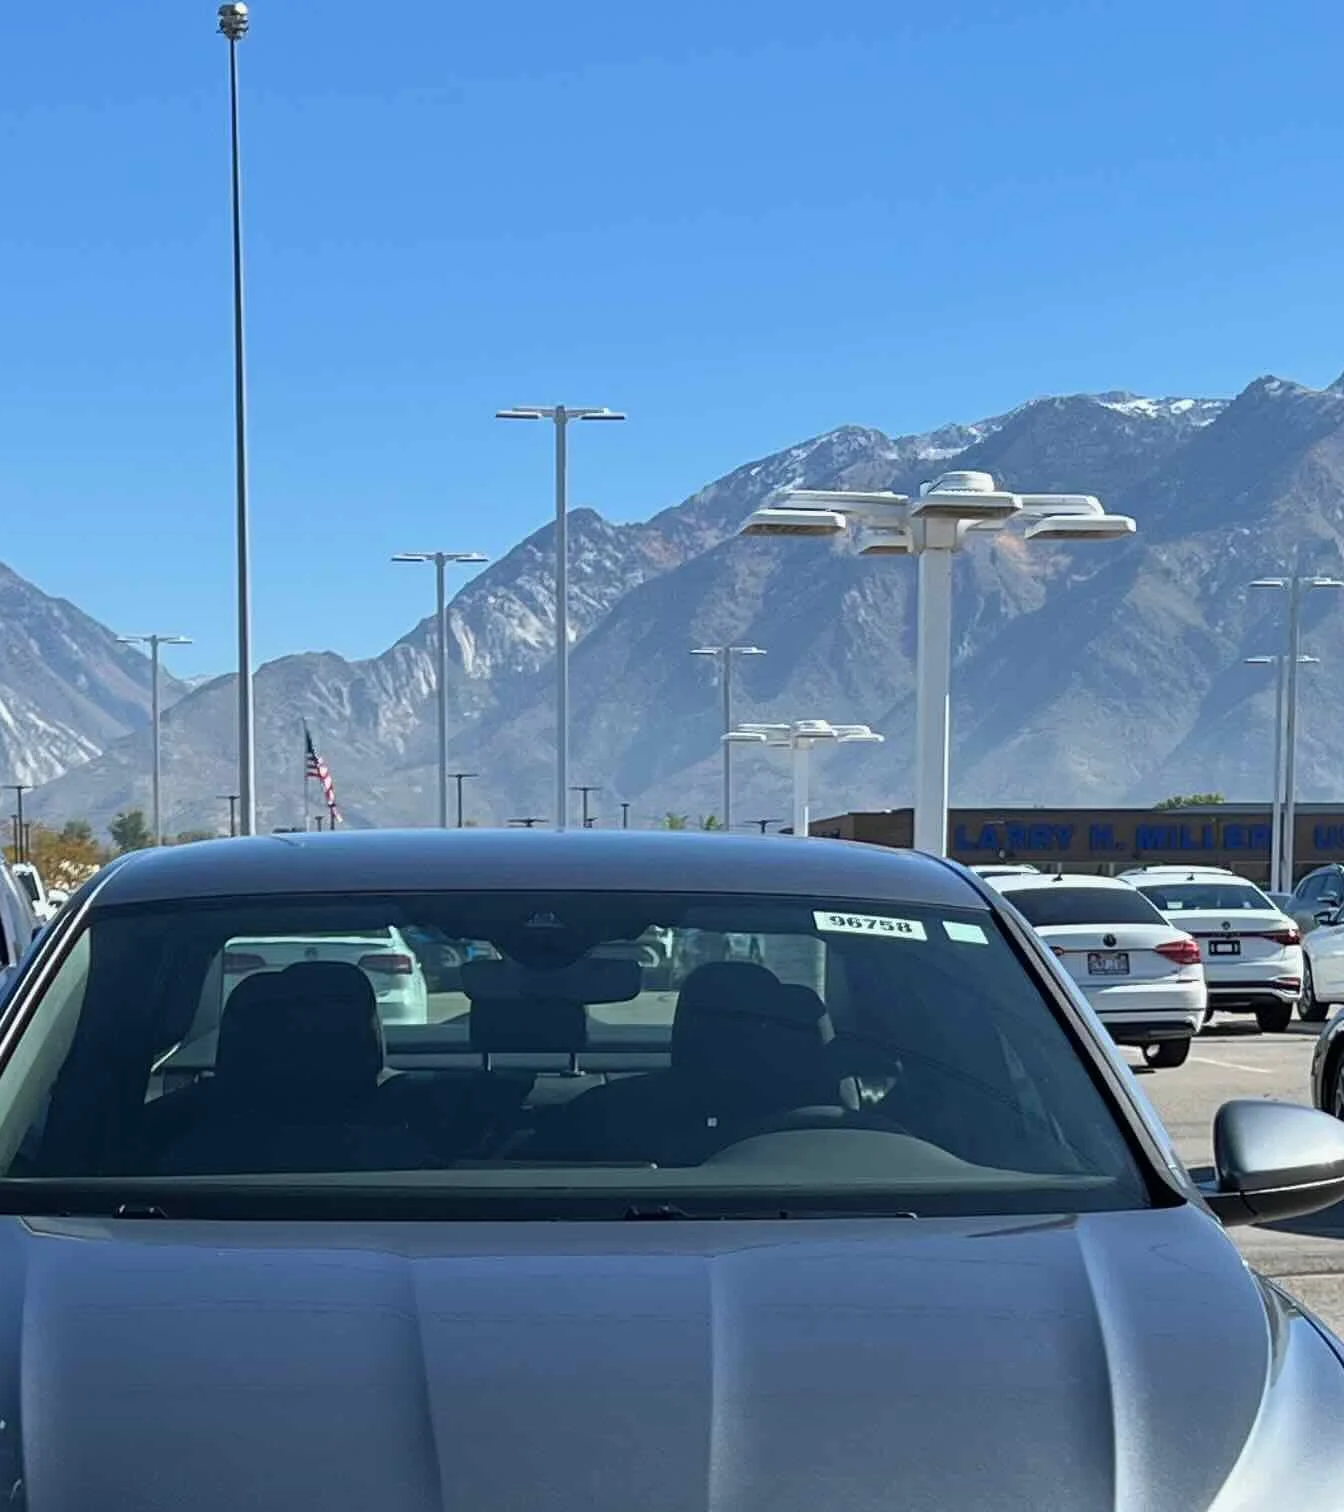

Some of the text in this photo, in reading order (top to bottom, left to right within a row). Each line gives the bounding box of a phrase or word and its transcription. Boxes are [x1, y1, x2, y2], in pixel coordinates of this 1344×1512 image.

[957, 823, 1073, 850] LARRY
[1135, 823, 1273, 850] MILLER
[828, 915, 913, 933] 96758
